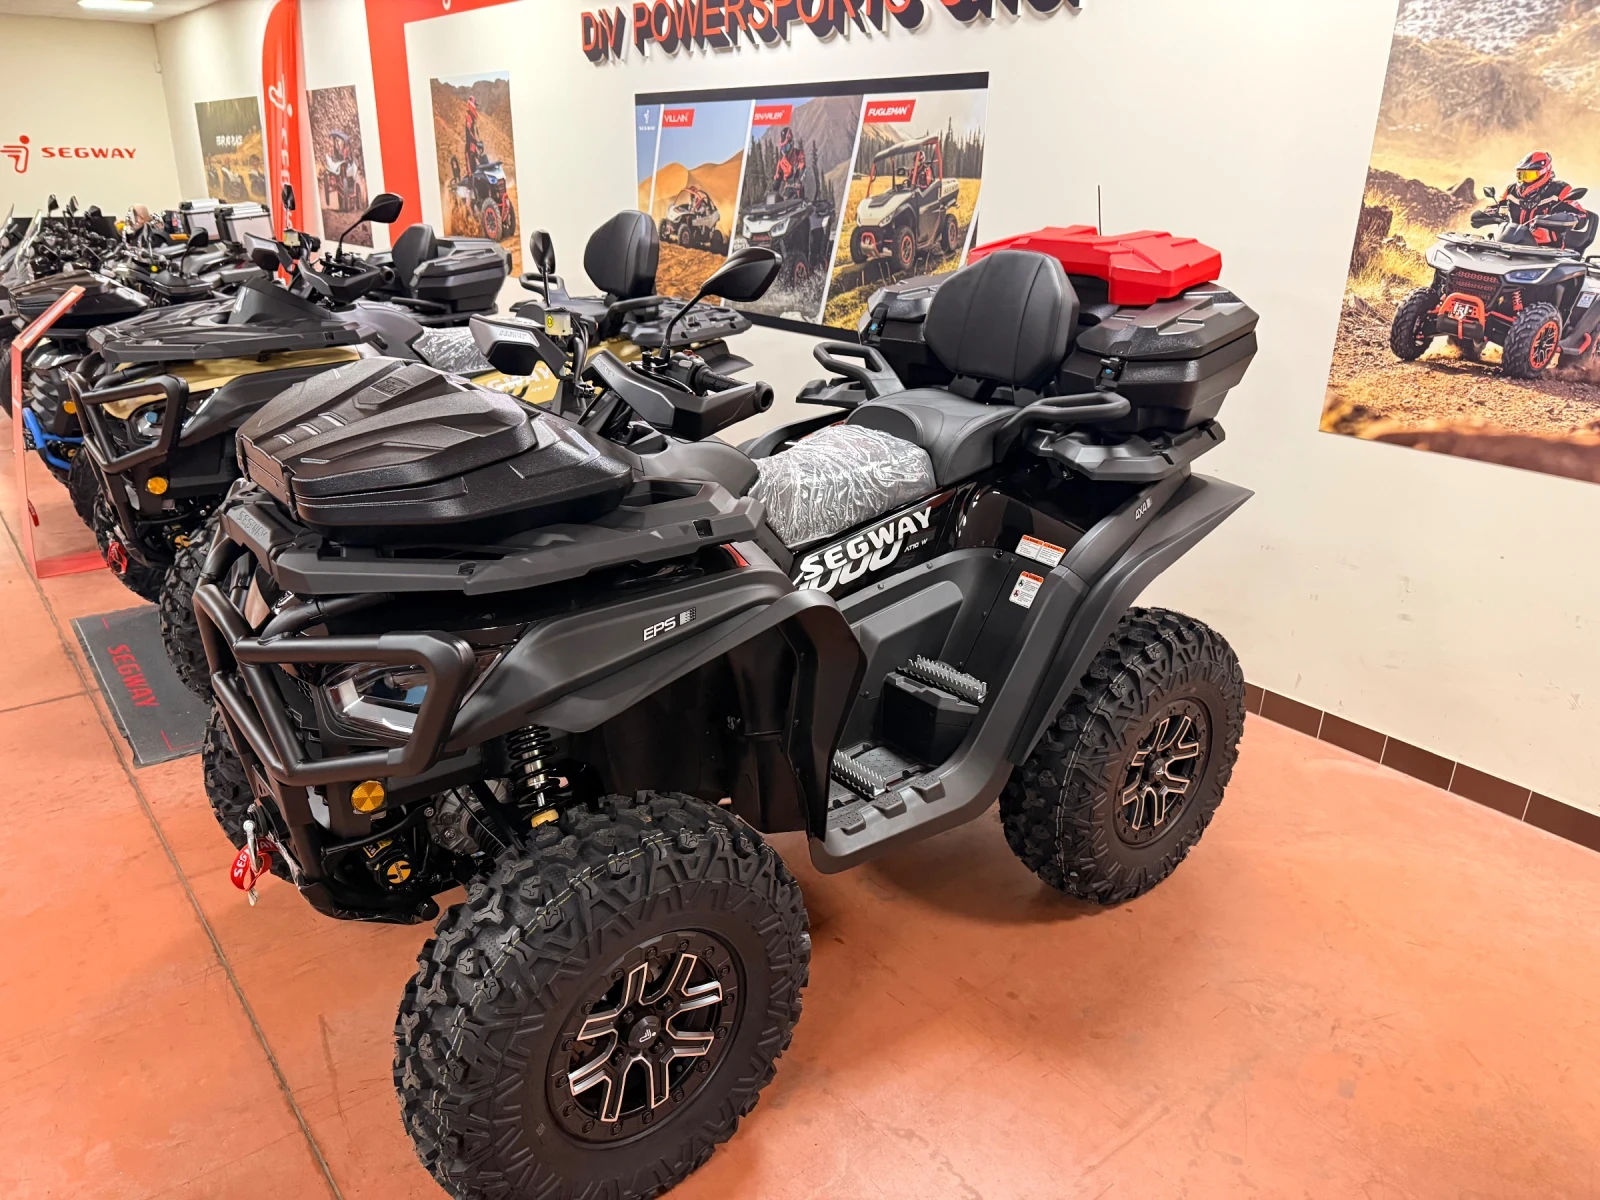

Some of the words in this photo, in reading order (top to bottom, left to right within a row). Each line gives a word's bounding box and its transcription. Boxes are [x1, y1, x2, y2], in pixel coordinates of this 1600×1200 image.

[581, 7, 623, 54] DIV
[664, 114, 689, 123] VILLAIN
[754, 110, 783, 121] SNARLER
[867, 106, 908, 117] FUGLEMAN
[41, 147, 136, 159] SEGWAY
[800, 506, 932, 581] SEGWAY
[643, 616, 676, 642] EPS
[107, 644, 160, 707] SEGWAY
